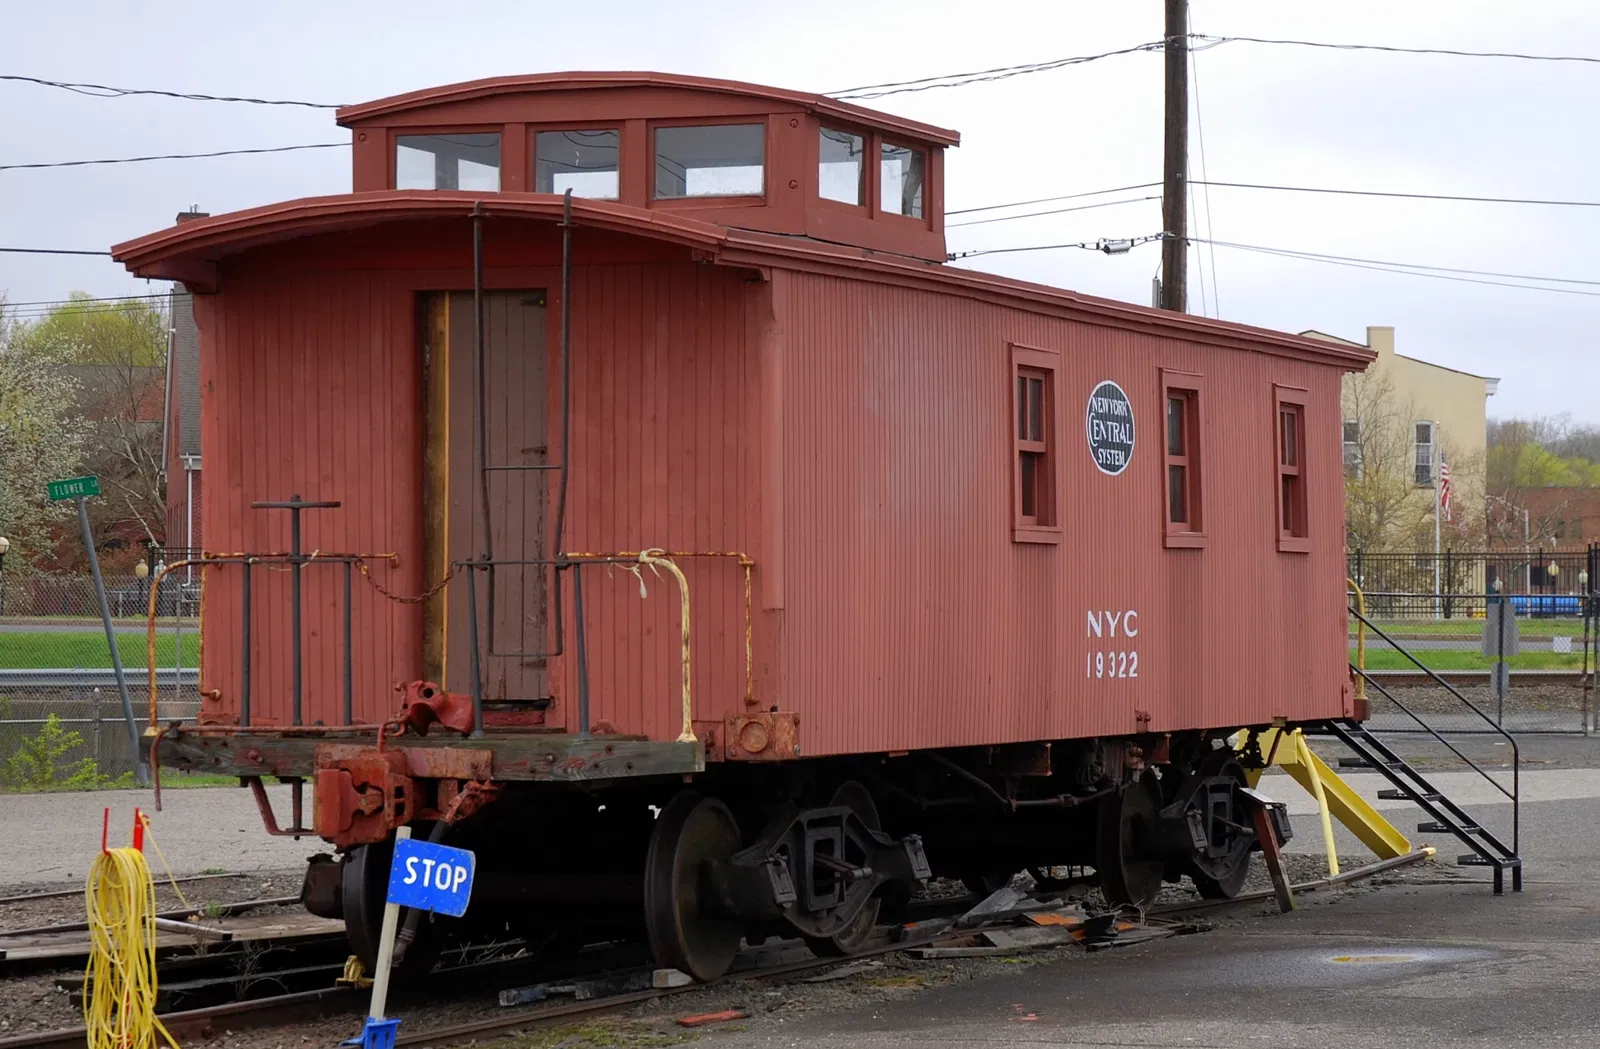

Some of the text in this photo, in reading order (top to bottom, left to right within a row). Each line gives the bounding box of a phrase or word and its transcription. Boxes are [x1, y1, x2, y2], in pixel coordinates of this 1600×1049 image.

[1092, 397, 1128, 417] NEW YORK
[1088, 412, 1133, 446] CENTRAL
[1098, 449, 1125, 465] SYSTEM
[54, 482, 84, 496] FLOWER
[1087, 610, 1138, 638] NYC
[1087, 651, 1138, 678] 19322
[403, 856, 467, 893] STOP
